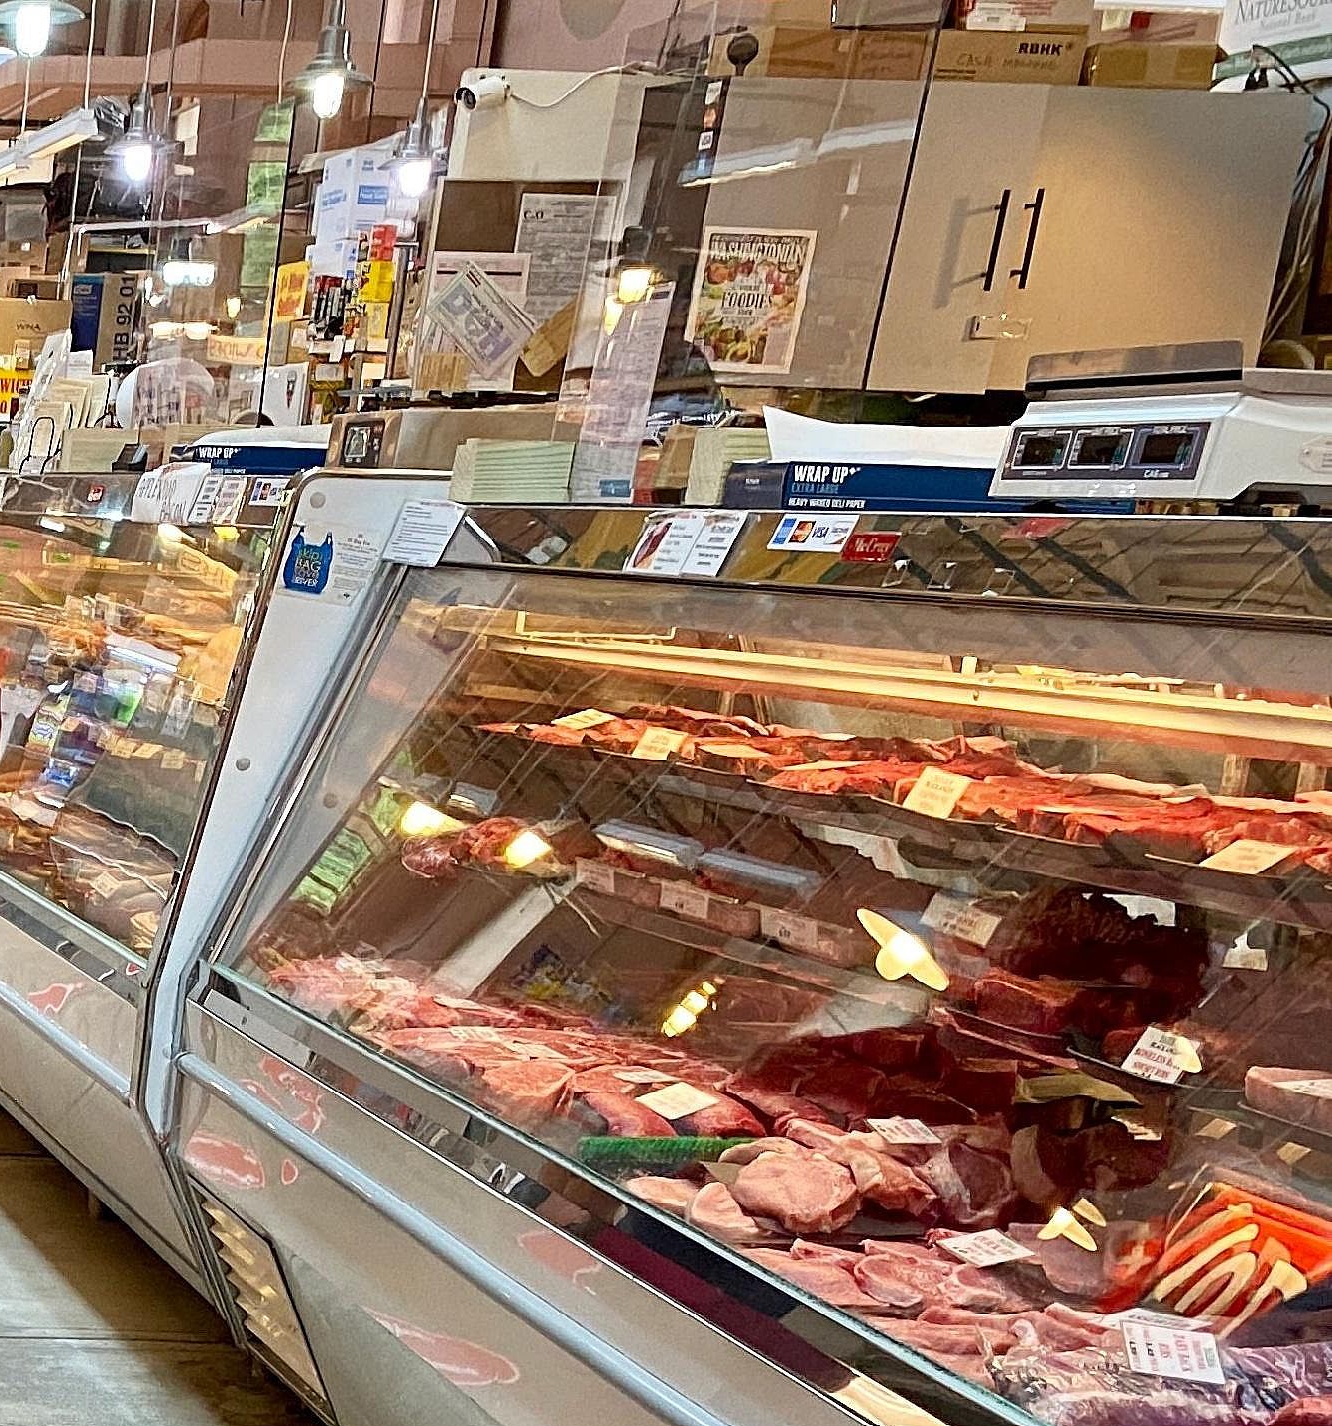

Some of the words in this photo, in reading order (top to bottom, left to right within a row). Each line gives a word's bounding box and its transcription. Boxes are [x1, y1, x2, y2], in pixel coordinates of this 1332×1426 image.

[120, 276, 136, 297] 01
[117, 302, 132, 326] 92
[199, 446, 223, 459] WRAP
[223, 447, 234, 459] UP
[794, 465, 831, 483] WRAP
[832, 466, 849, 484] UP
[791, 482, 815, 493] EXTRA
